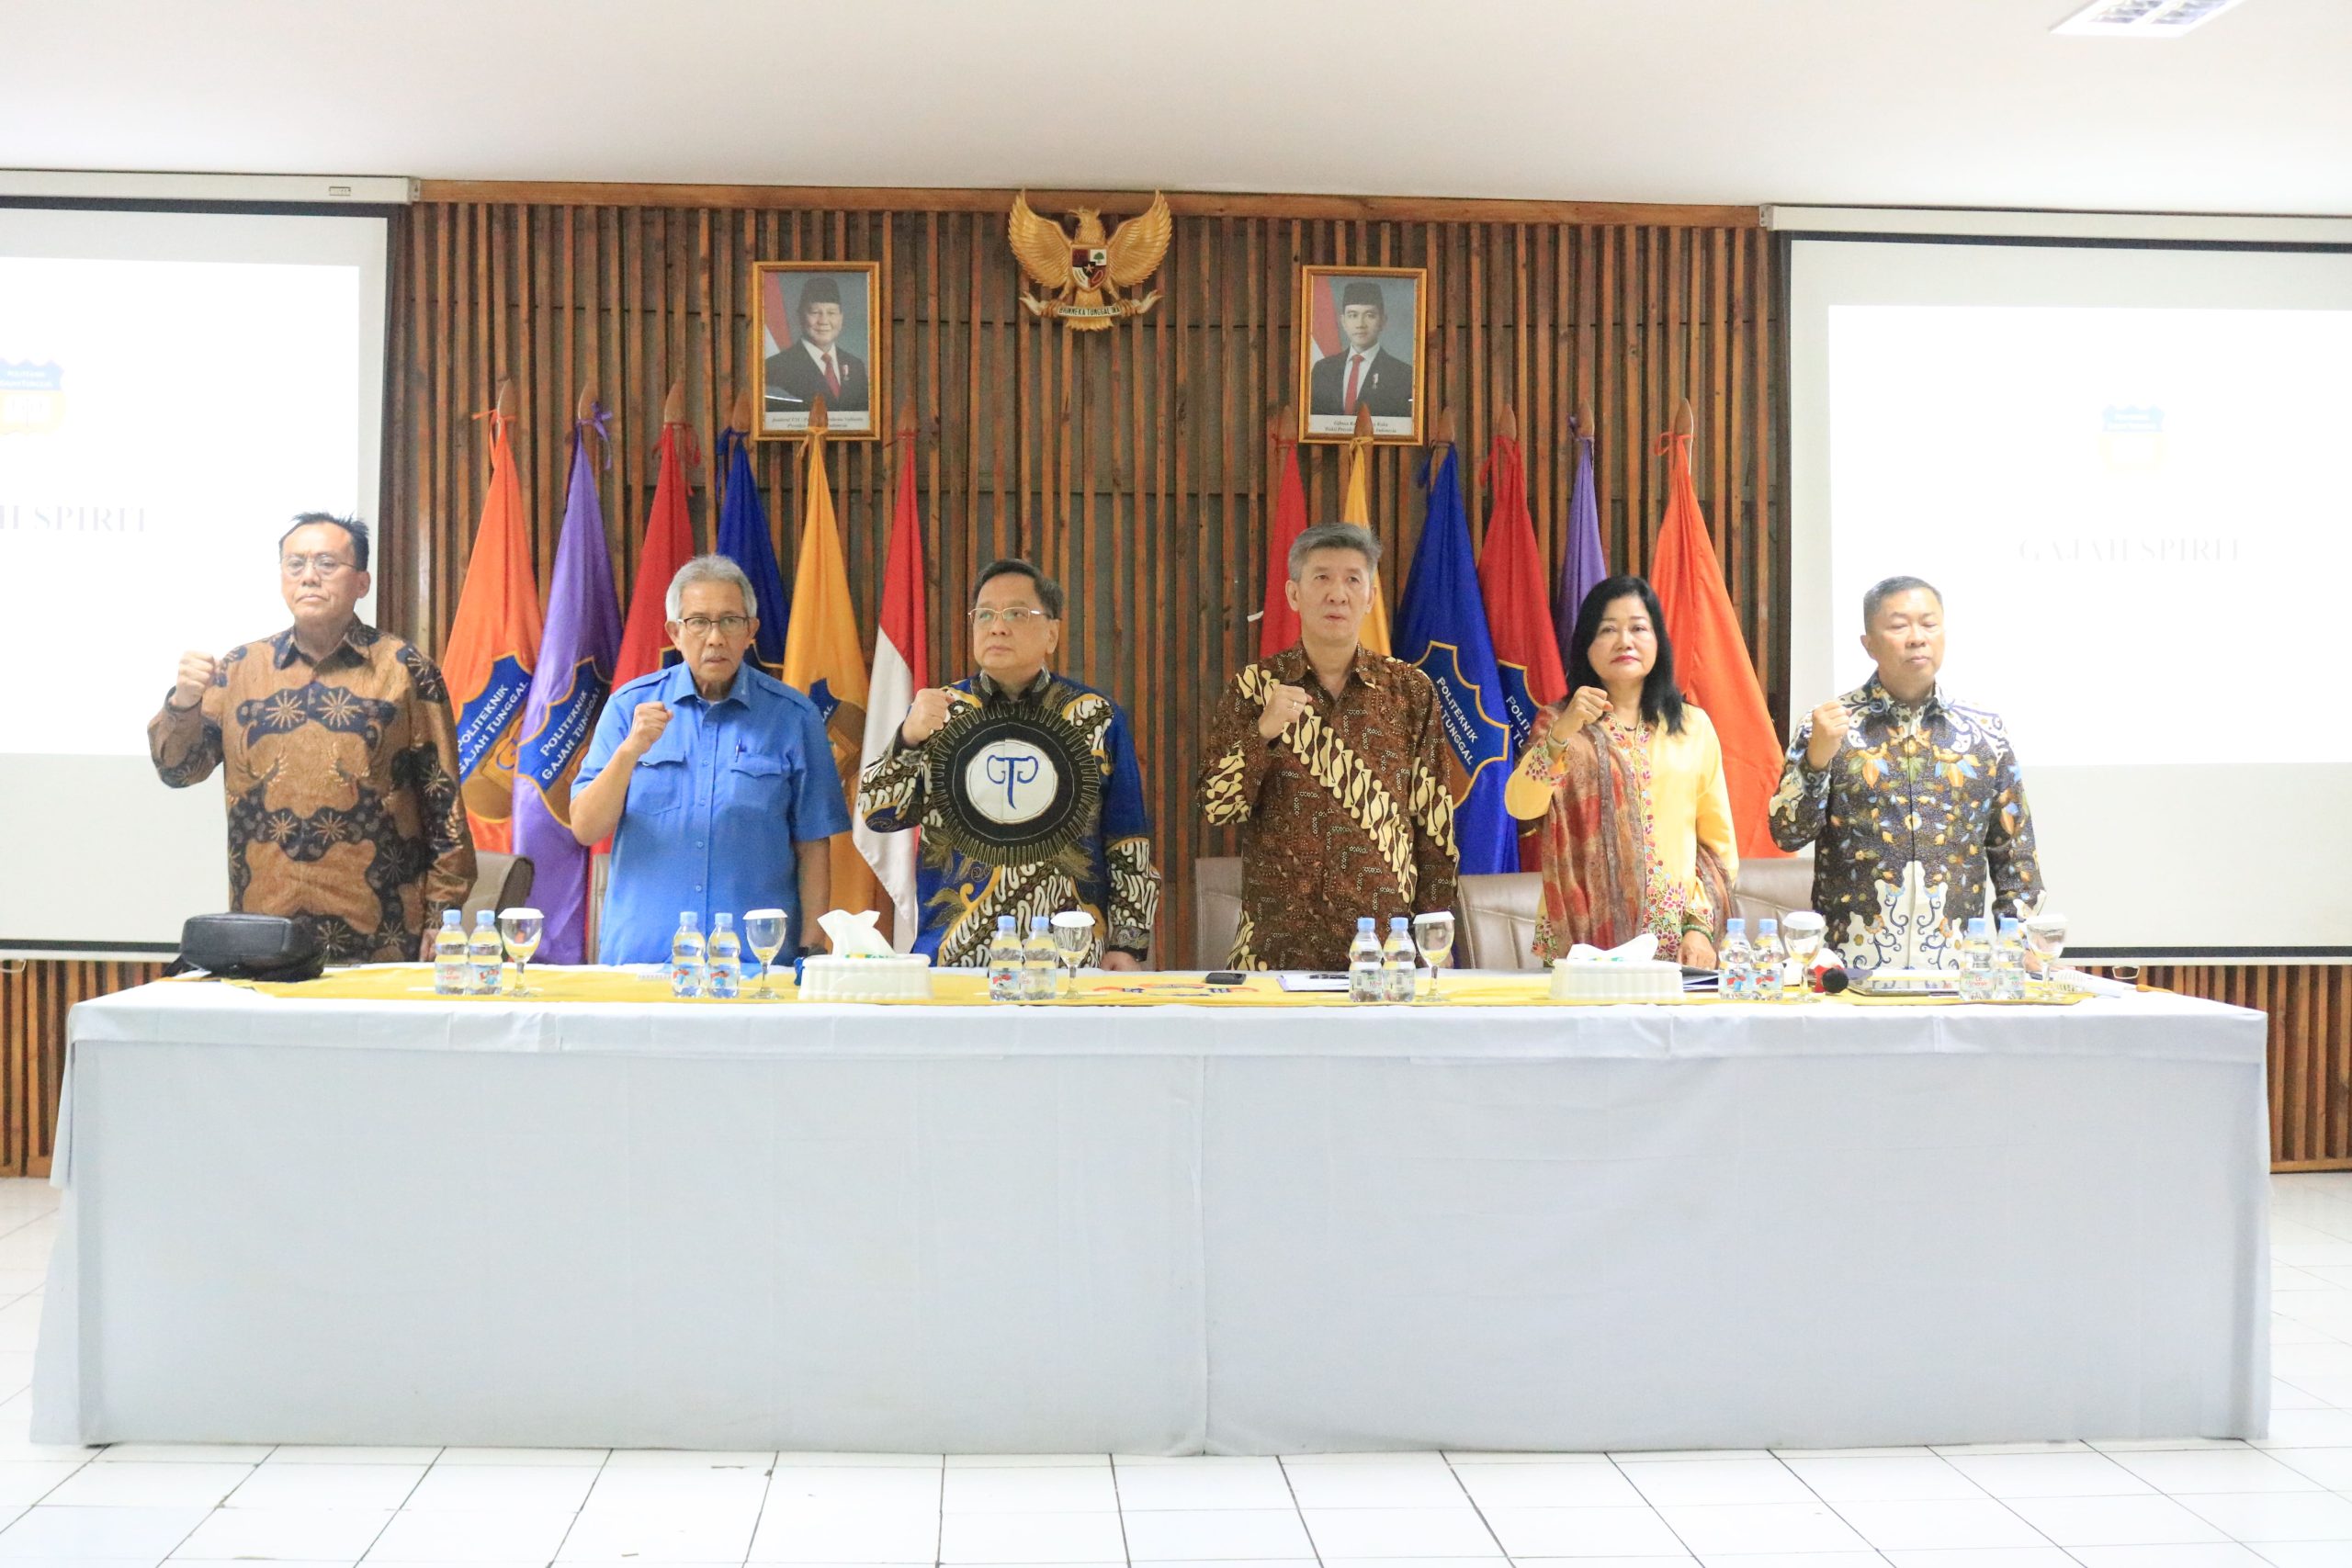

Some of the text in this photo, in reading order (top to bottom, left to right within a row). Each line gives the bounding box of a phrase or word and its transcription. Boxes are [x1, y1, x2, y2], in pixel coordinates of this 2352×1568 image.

[458, 683, 509, 752] POLITEKNIK
[458, 681, 529, 775] GAJAH TUNGGAL
[539, 690, 588, 757] POLITEKNIK
[1436, 676, 1479, 743] POLITEKNIK
[1441, 710, 1474, 765] TUNGGAL
[541, 739, 576, 780] GAJAH
